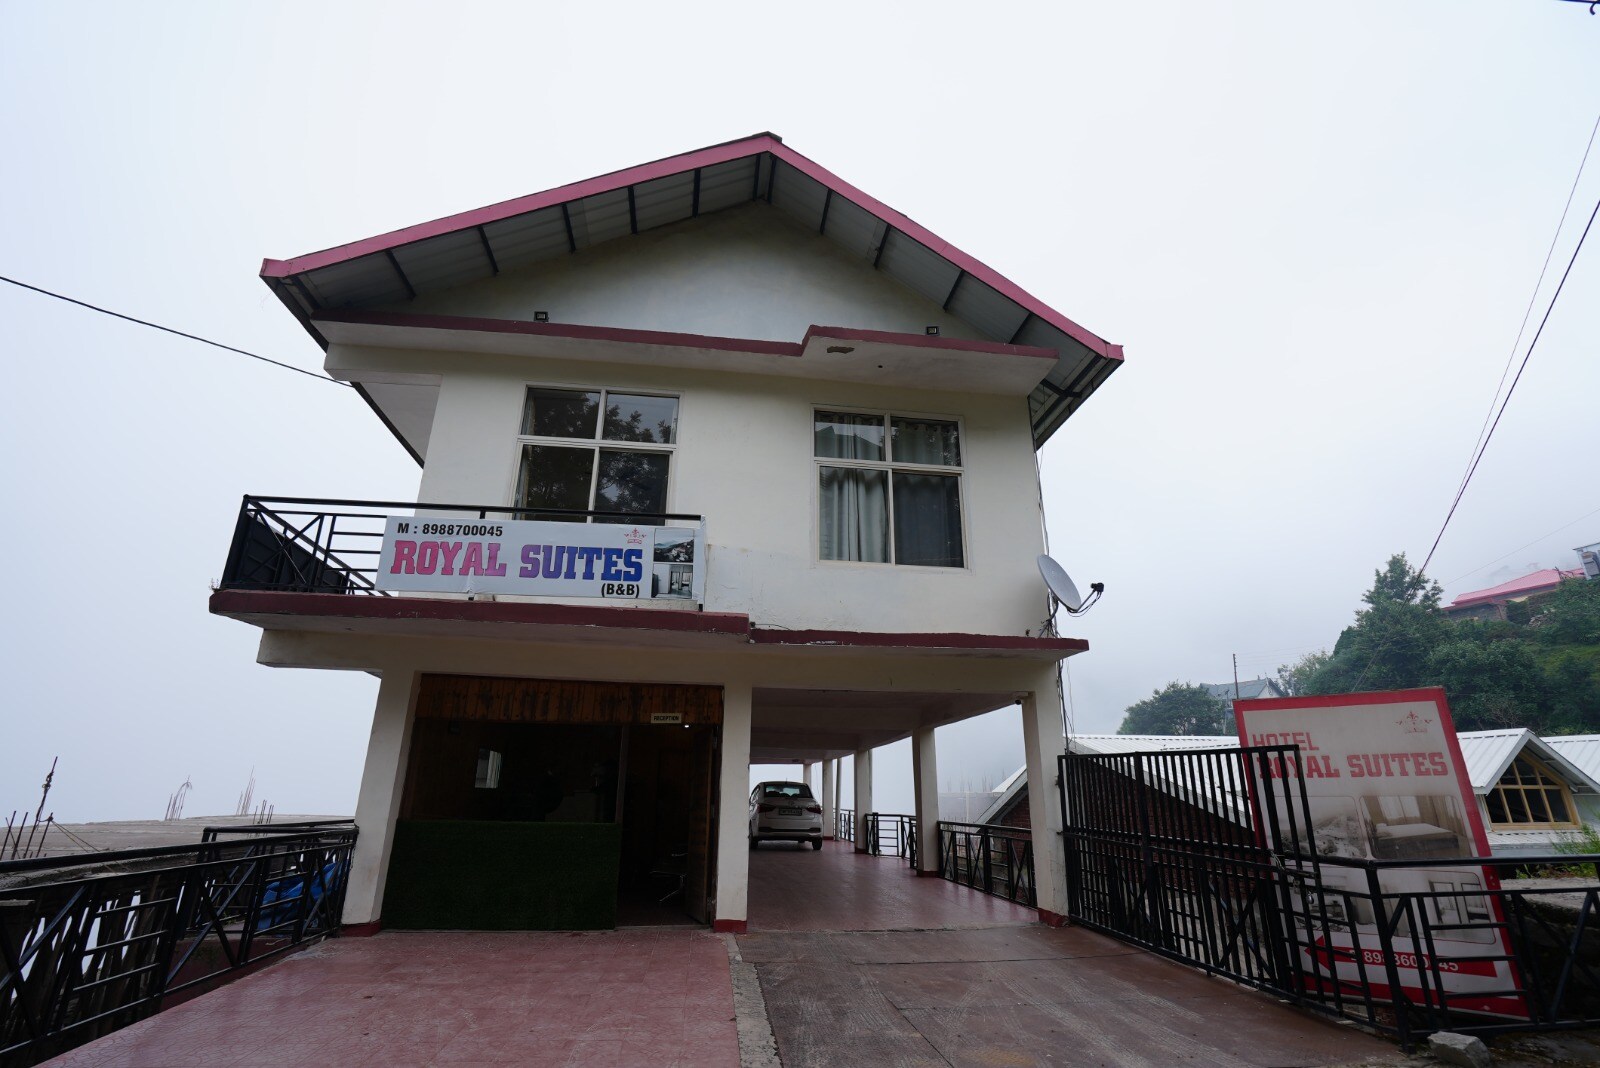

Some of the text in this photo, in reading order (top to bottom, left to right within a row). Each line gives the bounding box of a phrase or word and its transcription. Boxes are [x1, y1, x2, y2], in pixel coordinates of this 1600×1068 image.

[397, 523, 410, 534] M
[422, 524, 503, 536] 8988700045
[390, 540, 643, 582] ROYAL SUITES
[601, 583, 640, 598] (B&B)
[1252, 732, 1320, 751] HOTEL
[1346, 752, 1449, 778] SUITES
